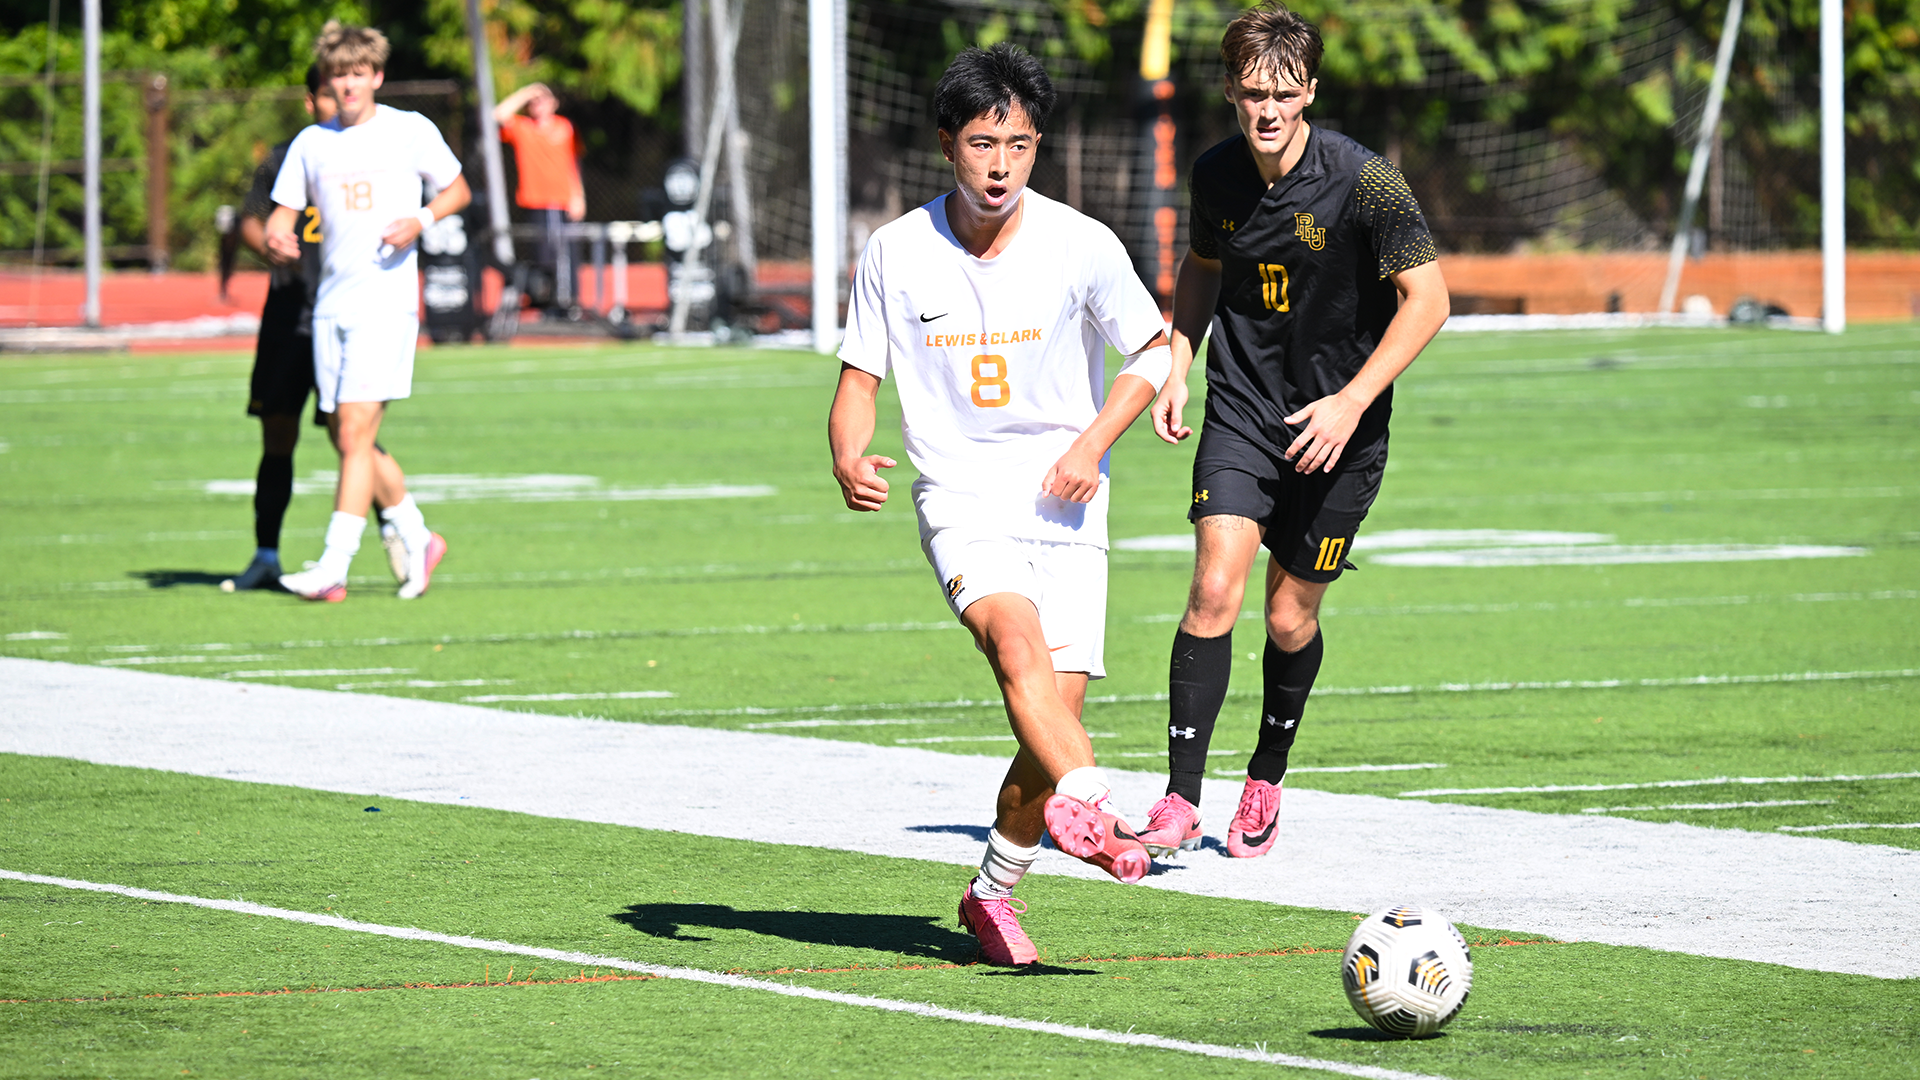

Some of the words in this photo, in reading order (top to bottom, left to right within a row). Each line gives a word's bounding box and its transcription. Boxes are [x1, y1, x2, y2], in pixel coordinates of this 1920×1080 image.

[340, 181, 373, 211] 18
[1258, 263, 1290, 313] 10
[925, 333, 976, 347] LEWIS
[979, 332, 988, 346] &
[990, 328, 1043, 345] CLARK
[970, 354, 1011, 408] 8
[1313, 536, 1346, 571] 10
